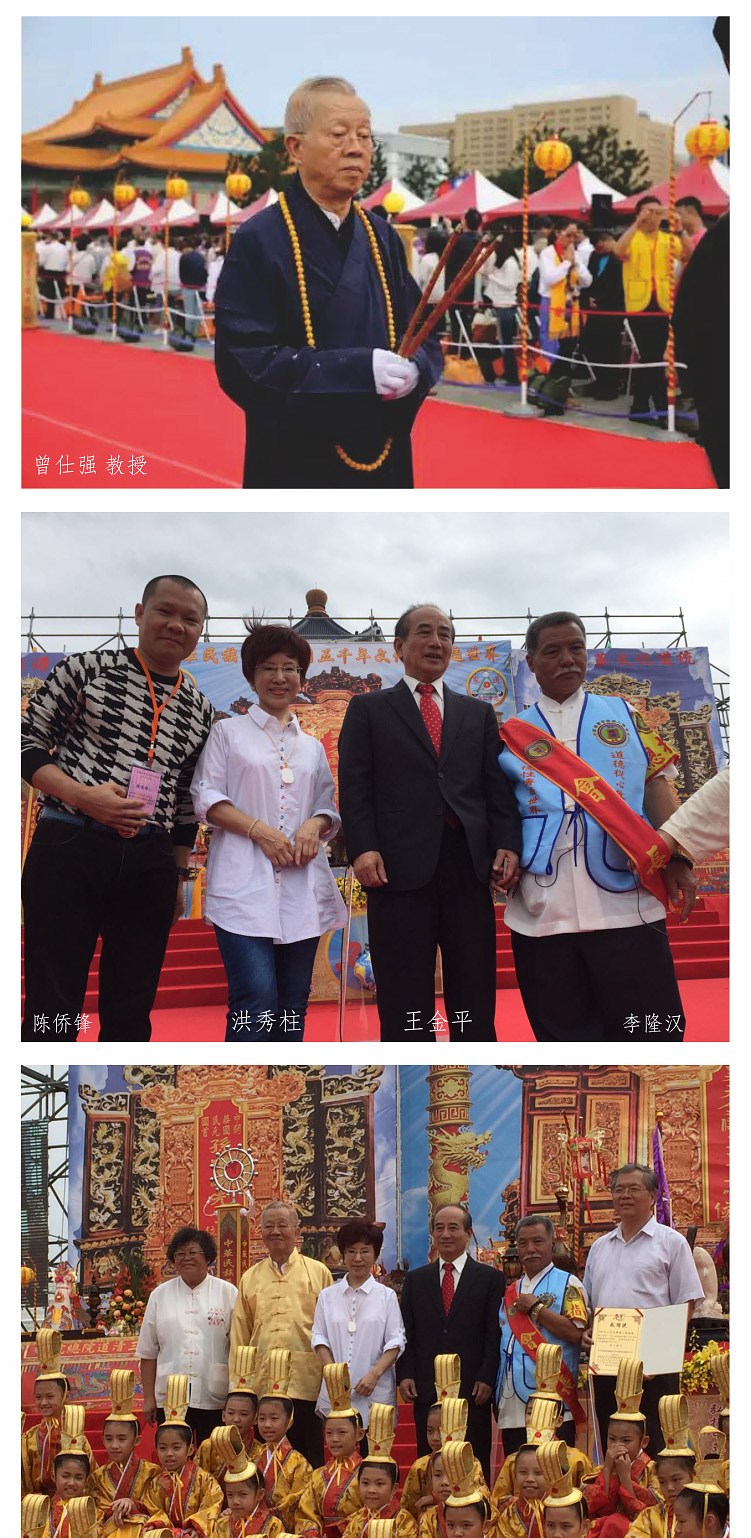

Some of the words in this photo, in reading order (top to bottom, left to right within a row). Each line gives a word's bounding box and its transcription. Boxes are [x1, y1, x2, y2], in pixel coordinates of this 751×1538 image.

[223, 1239, 235, 1281] 中華民族
[571, 1304, 582, 1316] 指
